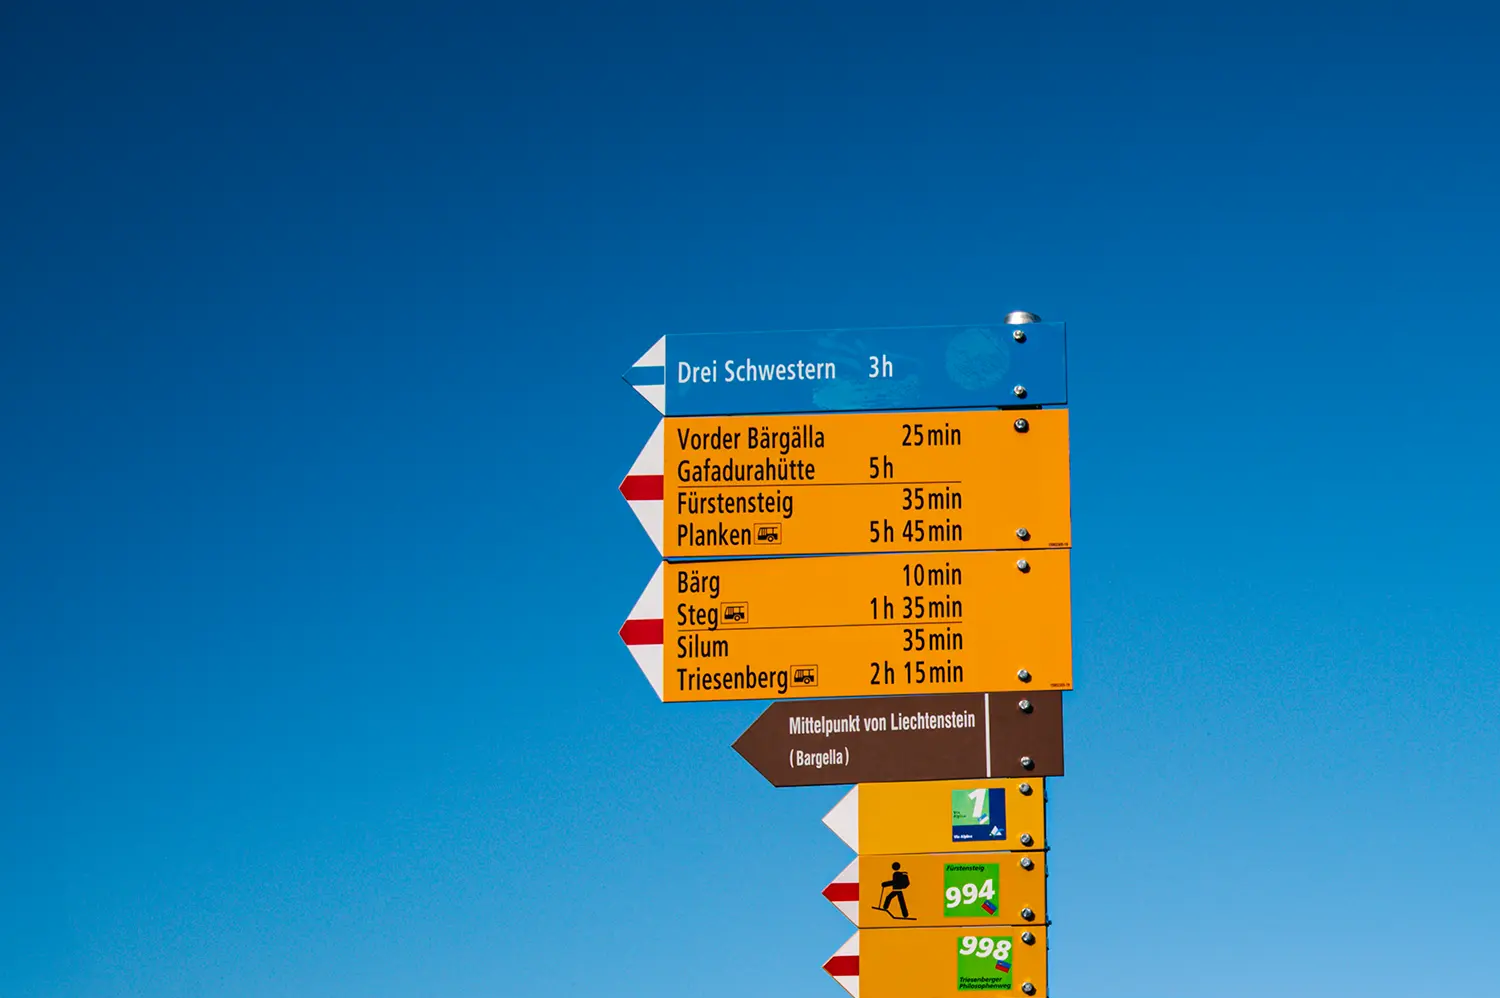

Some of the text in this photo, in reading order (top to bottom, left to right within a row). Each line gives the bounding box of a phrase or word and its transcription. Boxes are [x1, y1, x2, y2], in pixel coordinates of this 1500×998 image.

[678, 359, 717, 384] Drei
[725, 358, 836, 383] Schwestern
[677, 427, 740, 450] Vorder
[748, 425, 825, 455] Bärgälla
[677, 456, 816, 482] Gafadurahütte
[677, 489, 793, 519] Fürstensteig
[677, 521, 752, 546] Planken
[677, 570, 720, 599] Bärg
[677, 603, 719, 631] Steg
[677, 634, 729, 659] Silum
[677, 665, 788, 694] Triesenberg
[789, 710, 976, 738] Mittelpunkt von Liechtenstein
[789, 746, 850, 769] (Bargella)
[968, 788, 987, 818] 1
[945, 879, 996, 909] 994
[959, 936, 1012, 961] 998
